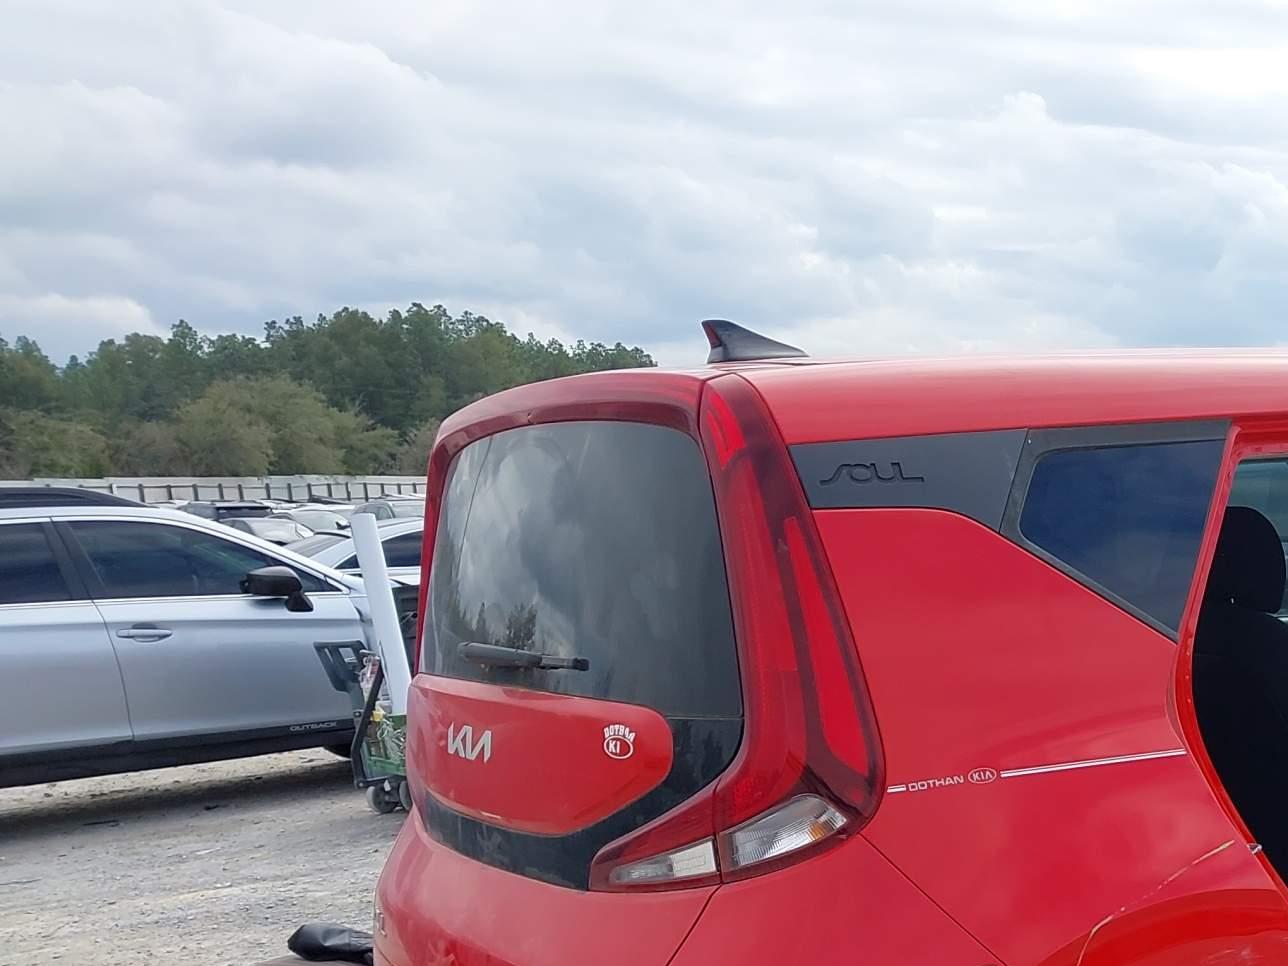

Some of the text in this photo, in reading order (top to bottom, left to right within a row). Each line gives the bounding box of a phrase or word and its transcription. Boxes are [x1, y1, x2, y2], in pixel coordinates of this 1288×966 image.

[819, 462, 925, 486] SOUL
[290, 721, 337, 731] OUTBACK
[908, 769, 993, 792] DOTHAN KIA
